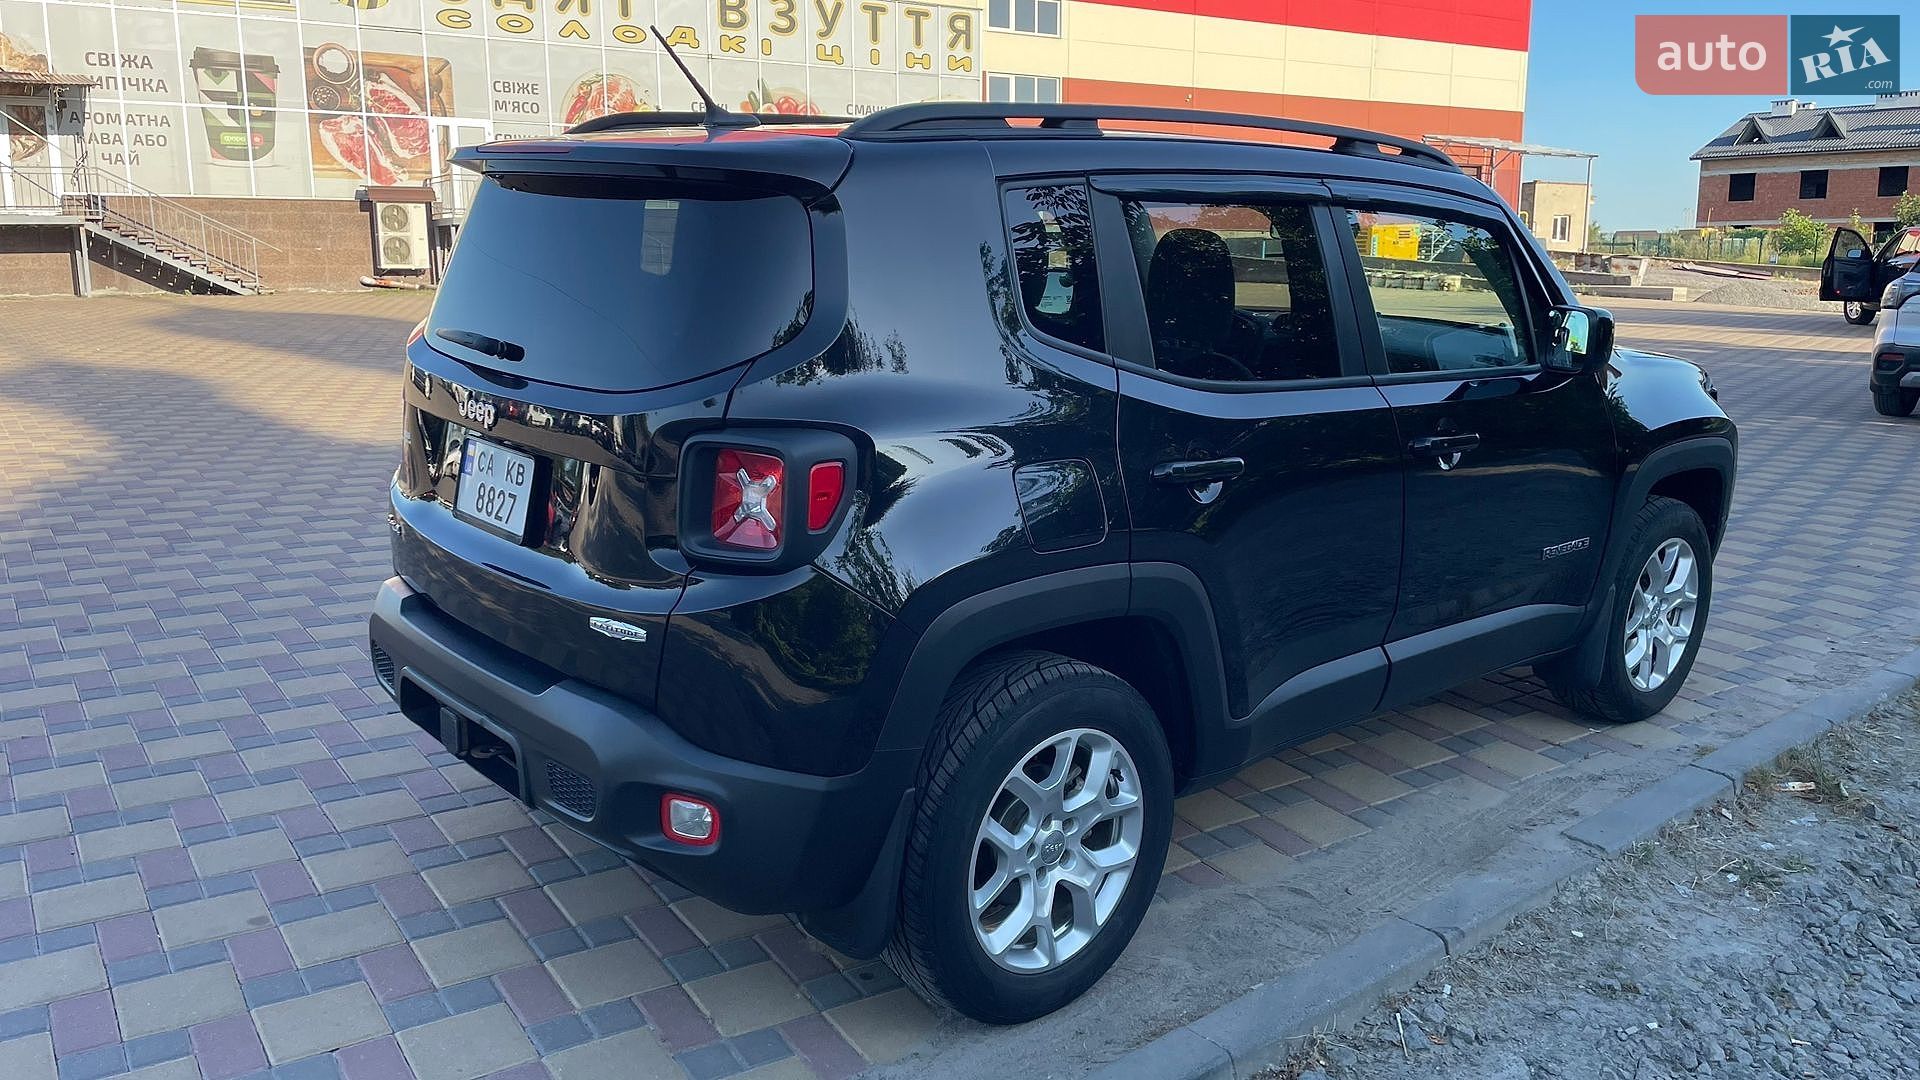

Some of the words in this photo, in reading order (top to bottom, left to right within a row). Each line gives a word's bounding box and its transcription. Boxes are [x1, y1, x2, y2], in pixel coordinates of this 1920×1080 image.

[718, 0, 974, 52] ВЗУТТЯ
[84, 52, 154, 70] СВІЖА
[816, 44, 972, 72] ЦІНИ
[89, 75, 169, 93] ИПІЧКА
[493, 80, 540, 95] СВІЖЕ
[494, 99, 540, 114] М'ЯСО
[133, 134, 168, 147] АБО
[101, 150, 140, 166] ЧАЙ
[458, 392, 495, 429] Jeep
[476, 482, 517, 524] 8827
